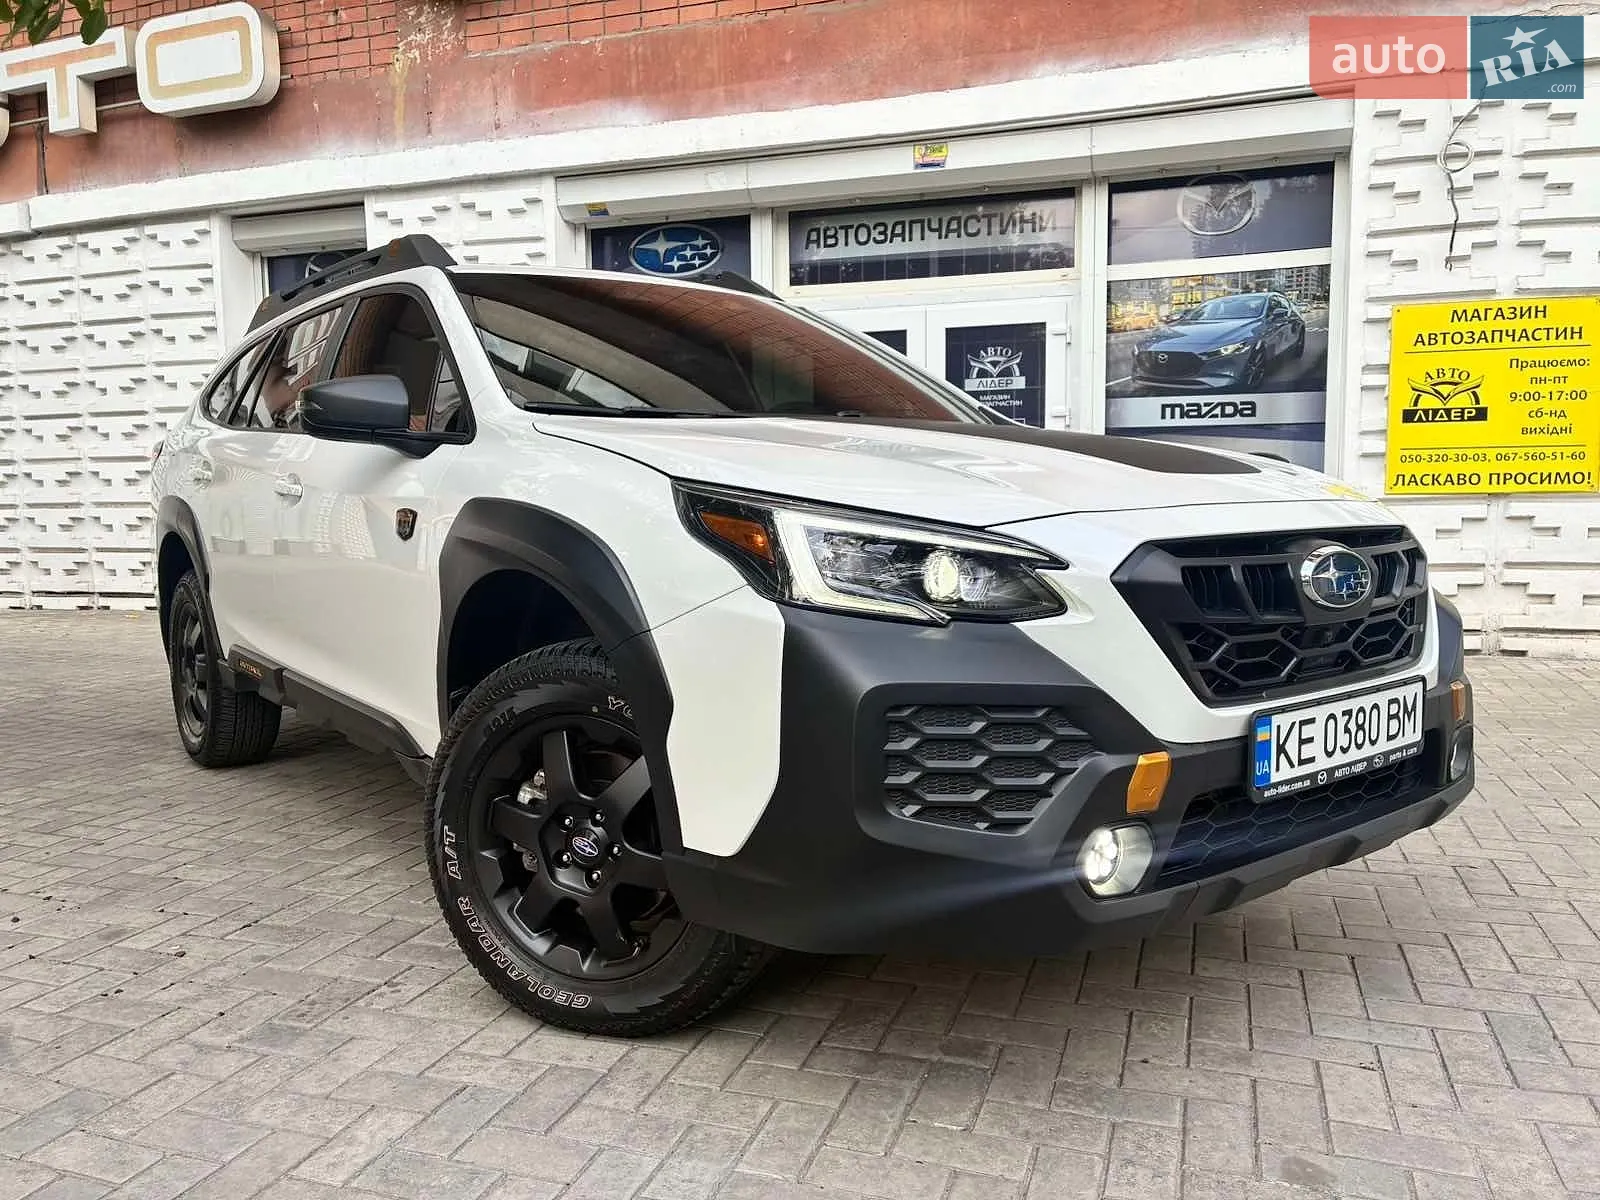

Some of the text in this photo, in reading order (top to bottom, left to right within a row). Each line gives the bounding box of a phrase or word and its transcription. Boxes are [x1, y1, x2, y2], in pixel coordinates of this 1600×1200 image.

[805, 208, 1057, 250] АВТОЗАПЧАСТИНИ
[1450, 305, 1548, 323] МАГАЗИН
[1413, 326, 1584, 347] АВТОЗАПЧАСТИН
[979, 346, 1012, 360] АВТО
[1509, 357, 1591, 371] Працюємо:
[1424, 367, 1471, 383] АВТО
[1529, 375, 1569, 386] пн-пт
[977, 378, 1013, 389] ЛІДЕР
[1509, 389, 1588, 402] 9:00-17:00
[1413, 409, 1477, 422] ЛІДЕР
[1528, 407, 1567, 419] сб-нд
[1520, 423, 1573, 436] вихідні
[1400, 451, 1587, 464] 050-320-30-03, 067-560-51-60
[1393, 471, 1592, 487] ЛАСКАВО ПРОСИМО!
[1275, 691, 1418, 773] KE 0380 BM
[1256, 759, 1271, 776] UA
[1334, 767, 1350, 778] АВТО
[443, 825, 592, 1010] GEOLANDAR A/T
